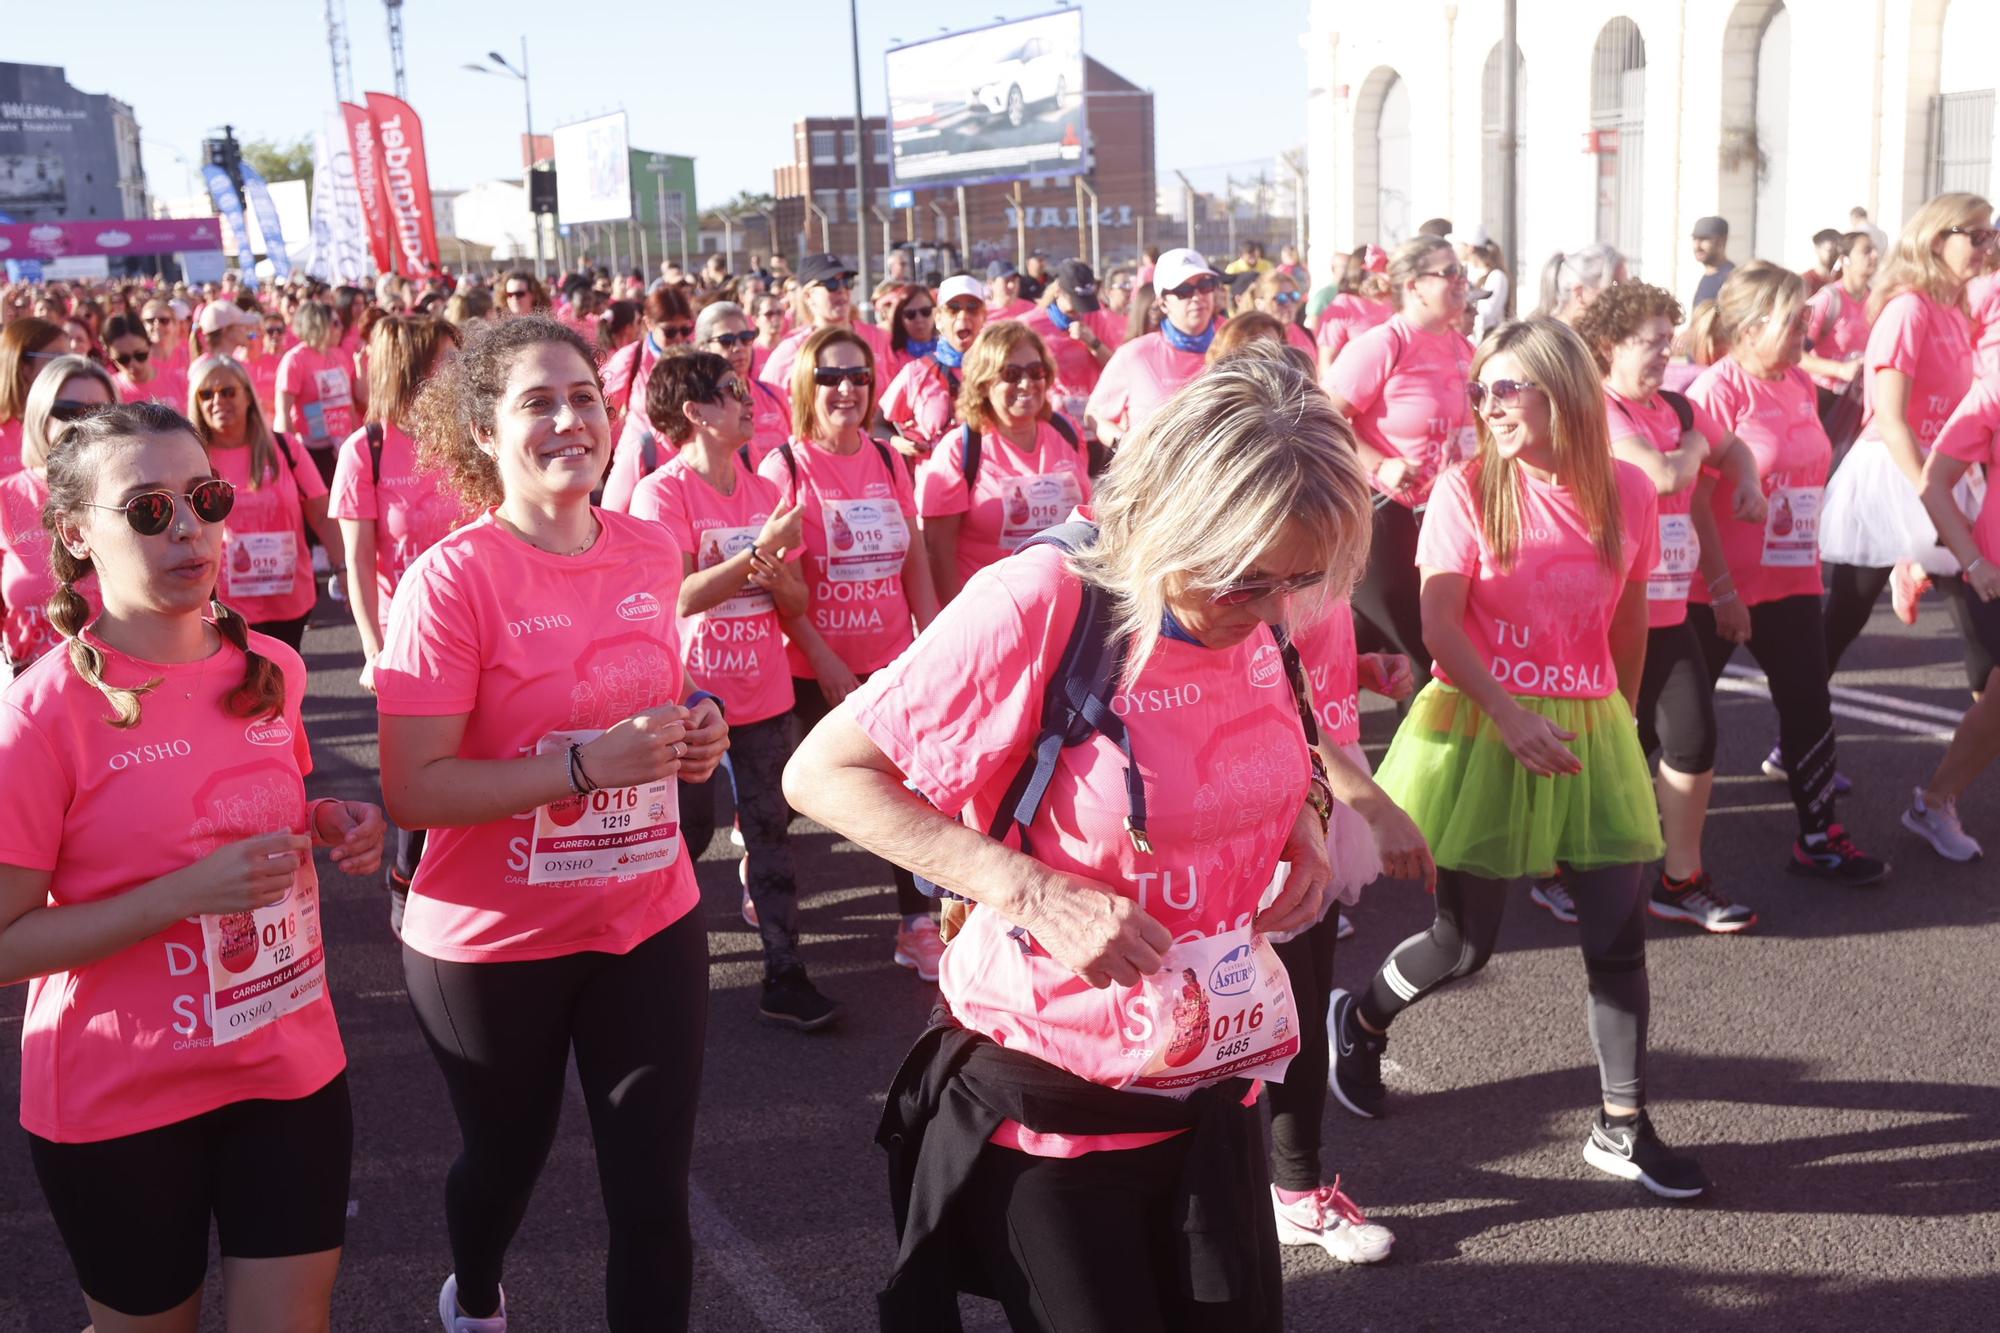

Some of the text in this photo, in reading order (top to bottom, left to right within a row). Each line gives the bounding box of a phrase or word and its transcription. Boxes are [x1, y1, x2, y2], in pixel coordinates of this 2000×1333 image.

[1031, 505, 1057, 518] 016
[855, 529, 883, 542] 016
[1664, 547, 1686, 561] 016
[816, 577, 898, 602] DORSAL
[507, 614, 572, 638] OYSHO
[816, 607, 882, 628] SUMA
[1495, 619, 1529, 649] TU
[690, 646, 759, 671] SUMA
[1491, 656, 1603, 692] DORSAL
[1109, 683, 1201, 717] OYSHO
[109, 739, 192, 770] OYSHO
[592, 786, 638, 812] 016
[601, 813, 631, 829] 1219
[553, 827, 668, 849] CARRERA DE LA MUJER 2023
[545, 848, 669, 872] OYSHO Santander
[1126, 864, 1198, 911] TU
[262, 912, 297, 948] 016
[232, 977, 272, 1000] CARRERA
[273, 974, 283, 986] DE
[283, 971, 293, 983] LA
[229, 1000, 273, 1028] OYSHO
[1213, 1002, 1264, 1042] 016
[1215, 1037, 1251, 1061] 6485
[1235, 1054, 1267, 1069] MUJER
